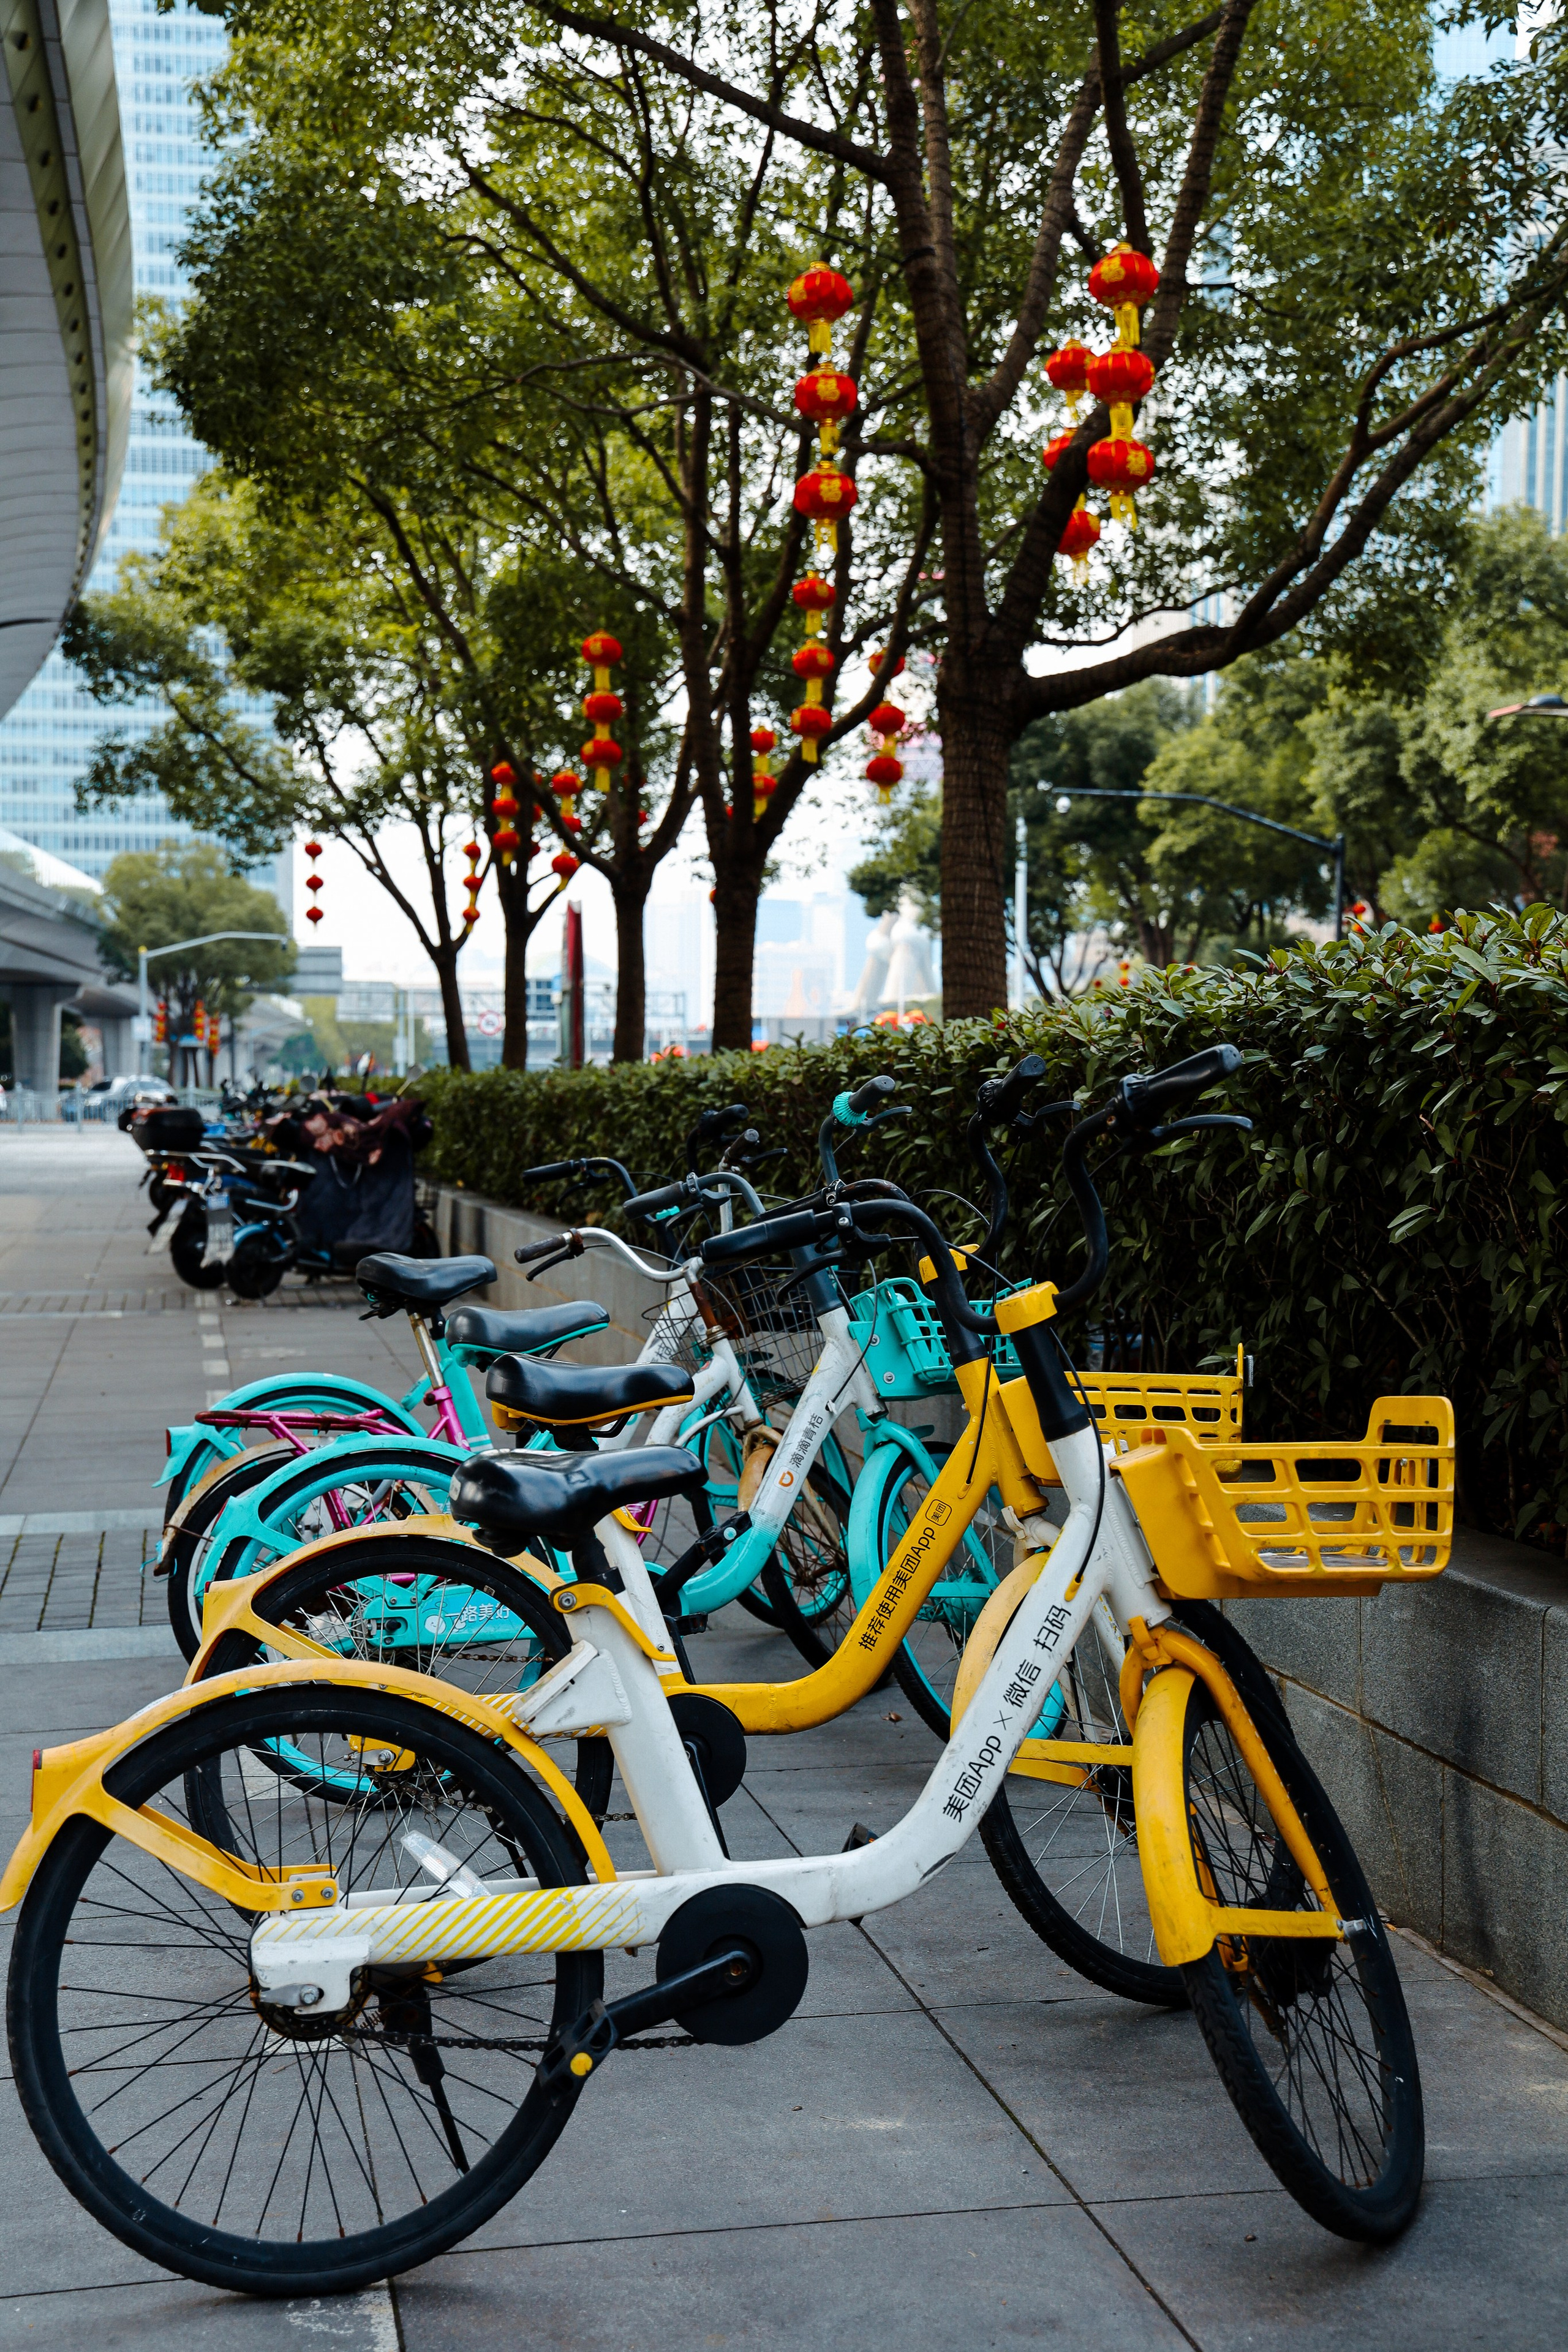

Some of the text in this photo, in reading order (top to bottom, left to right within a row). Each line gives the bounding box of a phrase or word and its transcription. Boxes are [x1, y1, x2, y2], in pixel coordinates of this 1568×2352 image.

[789, 1412, 824, 1468] 滴滴青桔
[931, 1502, 946, 1523] 美团
[445, 1603, 511, 1623] 一路美好
[858, 1526, 937, 1652] 推荐使用美团App
[943, 1735, 1003, 1823] 美团App
[1003, 1659, 1042, 1709] 微信
[1033, 1604, 1072, 1652] 扫码
